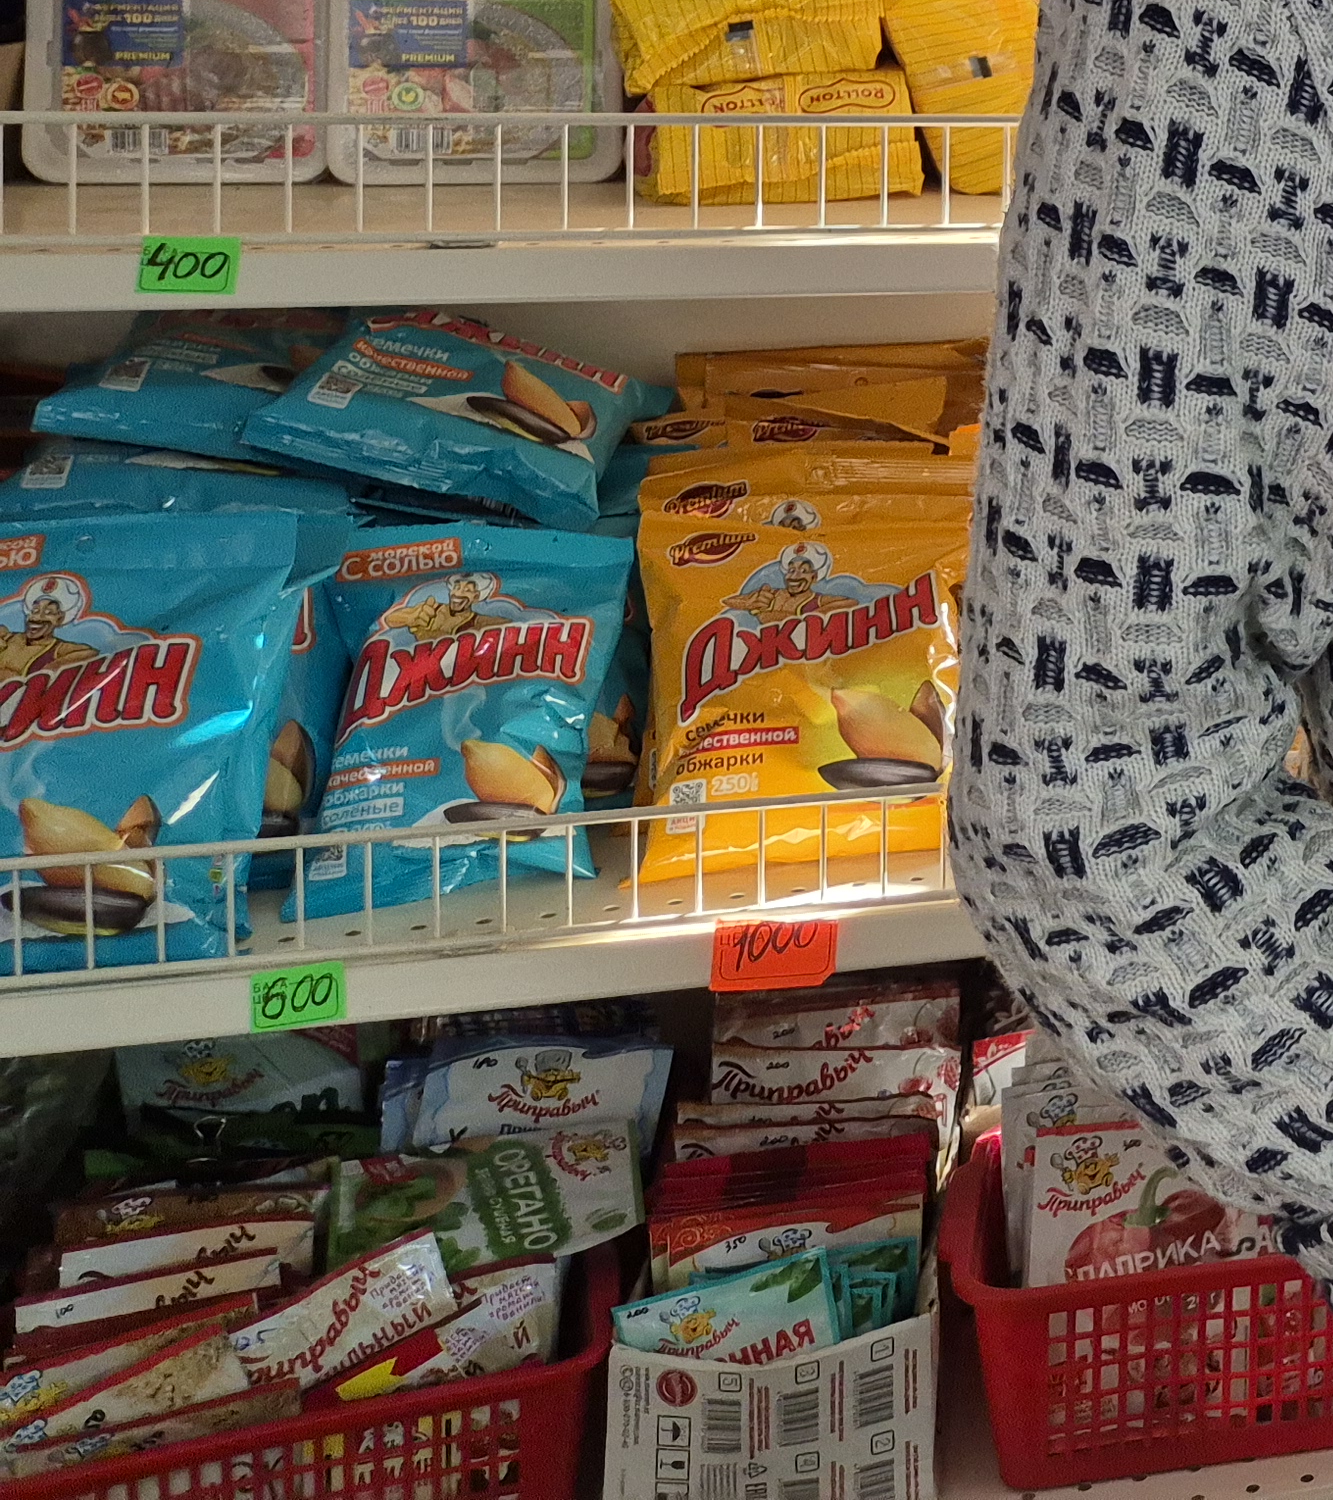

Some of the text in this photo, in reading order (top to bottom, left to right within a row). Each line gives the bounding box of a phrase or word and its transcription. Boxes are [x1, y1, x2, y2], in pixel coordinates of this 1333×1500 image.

[123, 13, 153, 24] 100
[408, 16, 438, 26] 100
[114, 51, 171, 61] PREMIUM
[401, 53, 455, 63] PREMIUM
[810, 87, 886, 106] ROLLTON
[149, 242, 230, 282] 400
[669, 532, 756, 568] Premium
[675, 751, 765, 776] обжарки
[492, 1148, 559, 1250] ОРЕГАНО
[1035, 1162, 1147, 1218] Приправыч
[724, 1235, 747, 1254] 350
